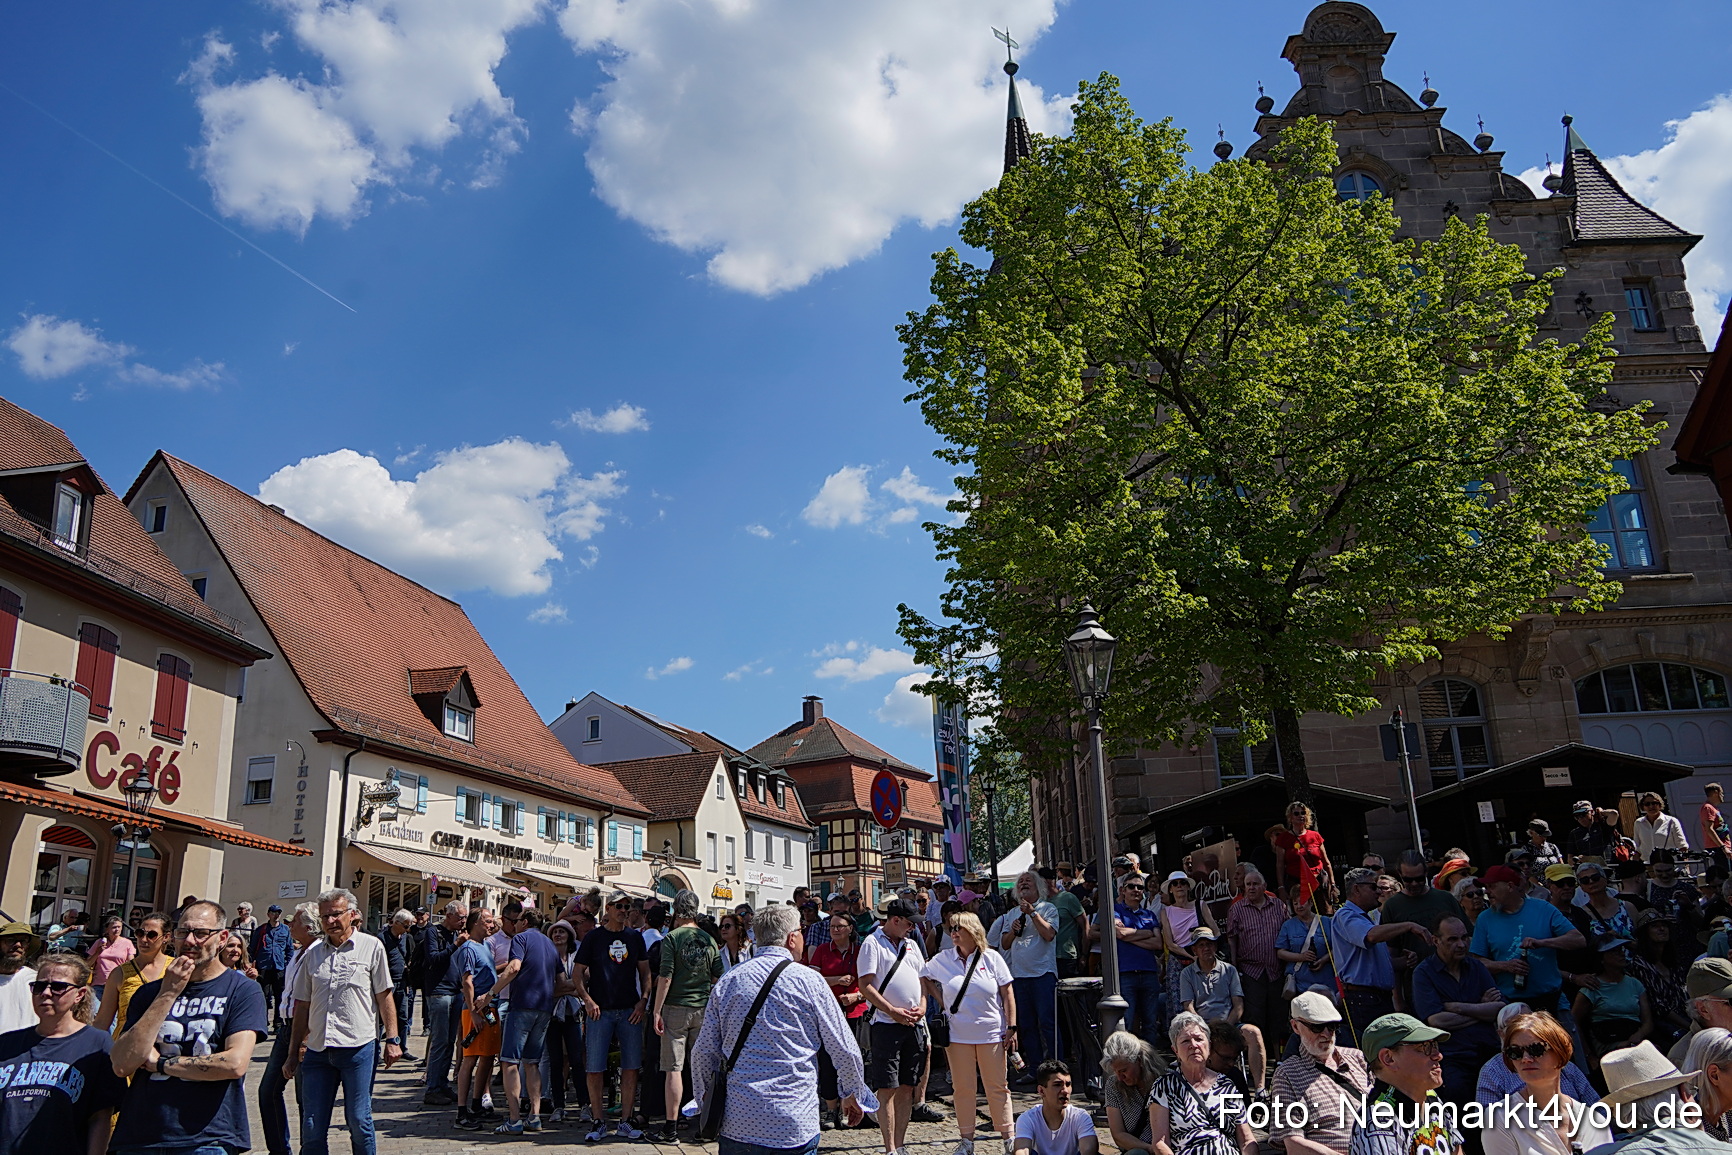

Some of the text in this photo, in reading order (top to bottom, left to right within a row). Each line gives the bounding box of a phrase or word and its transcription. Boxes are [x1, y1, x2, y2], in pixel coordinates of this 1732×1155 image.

[86, 731, 181, 805] Café
[293, 766, 309, 834] HOTEL
[379, 822, 424, 843] BÄCKEREI
[465, 837, 485, 853] AM
[485, 841, 533, 862] RATHAUS
[472, 888, 484, 899] EIS
[6, 1089, 51, 1098] CALIFORNIA
[10, 1061, 85, 1104] ANGELES
